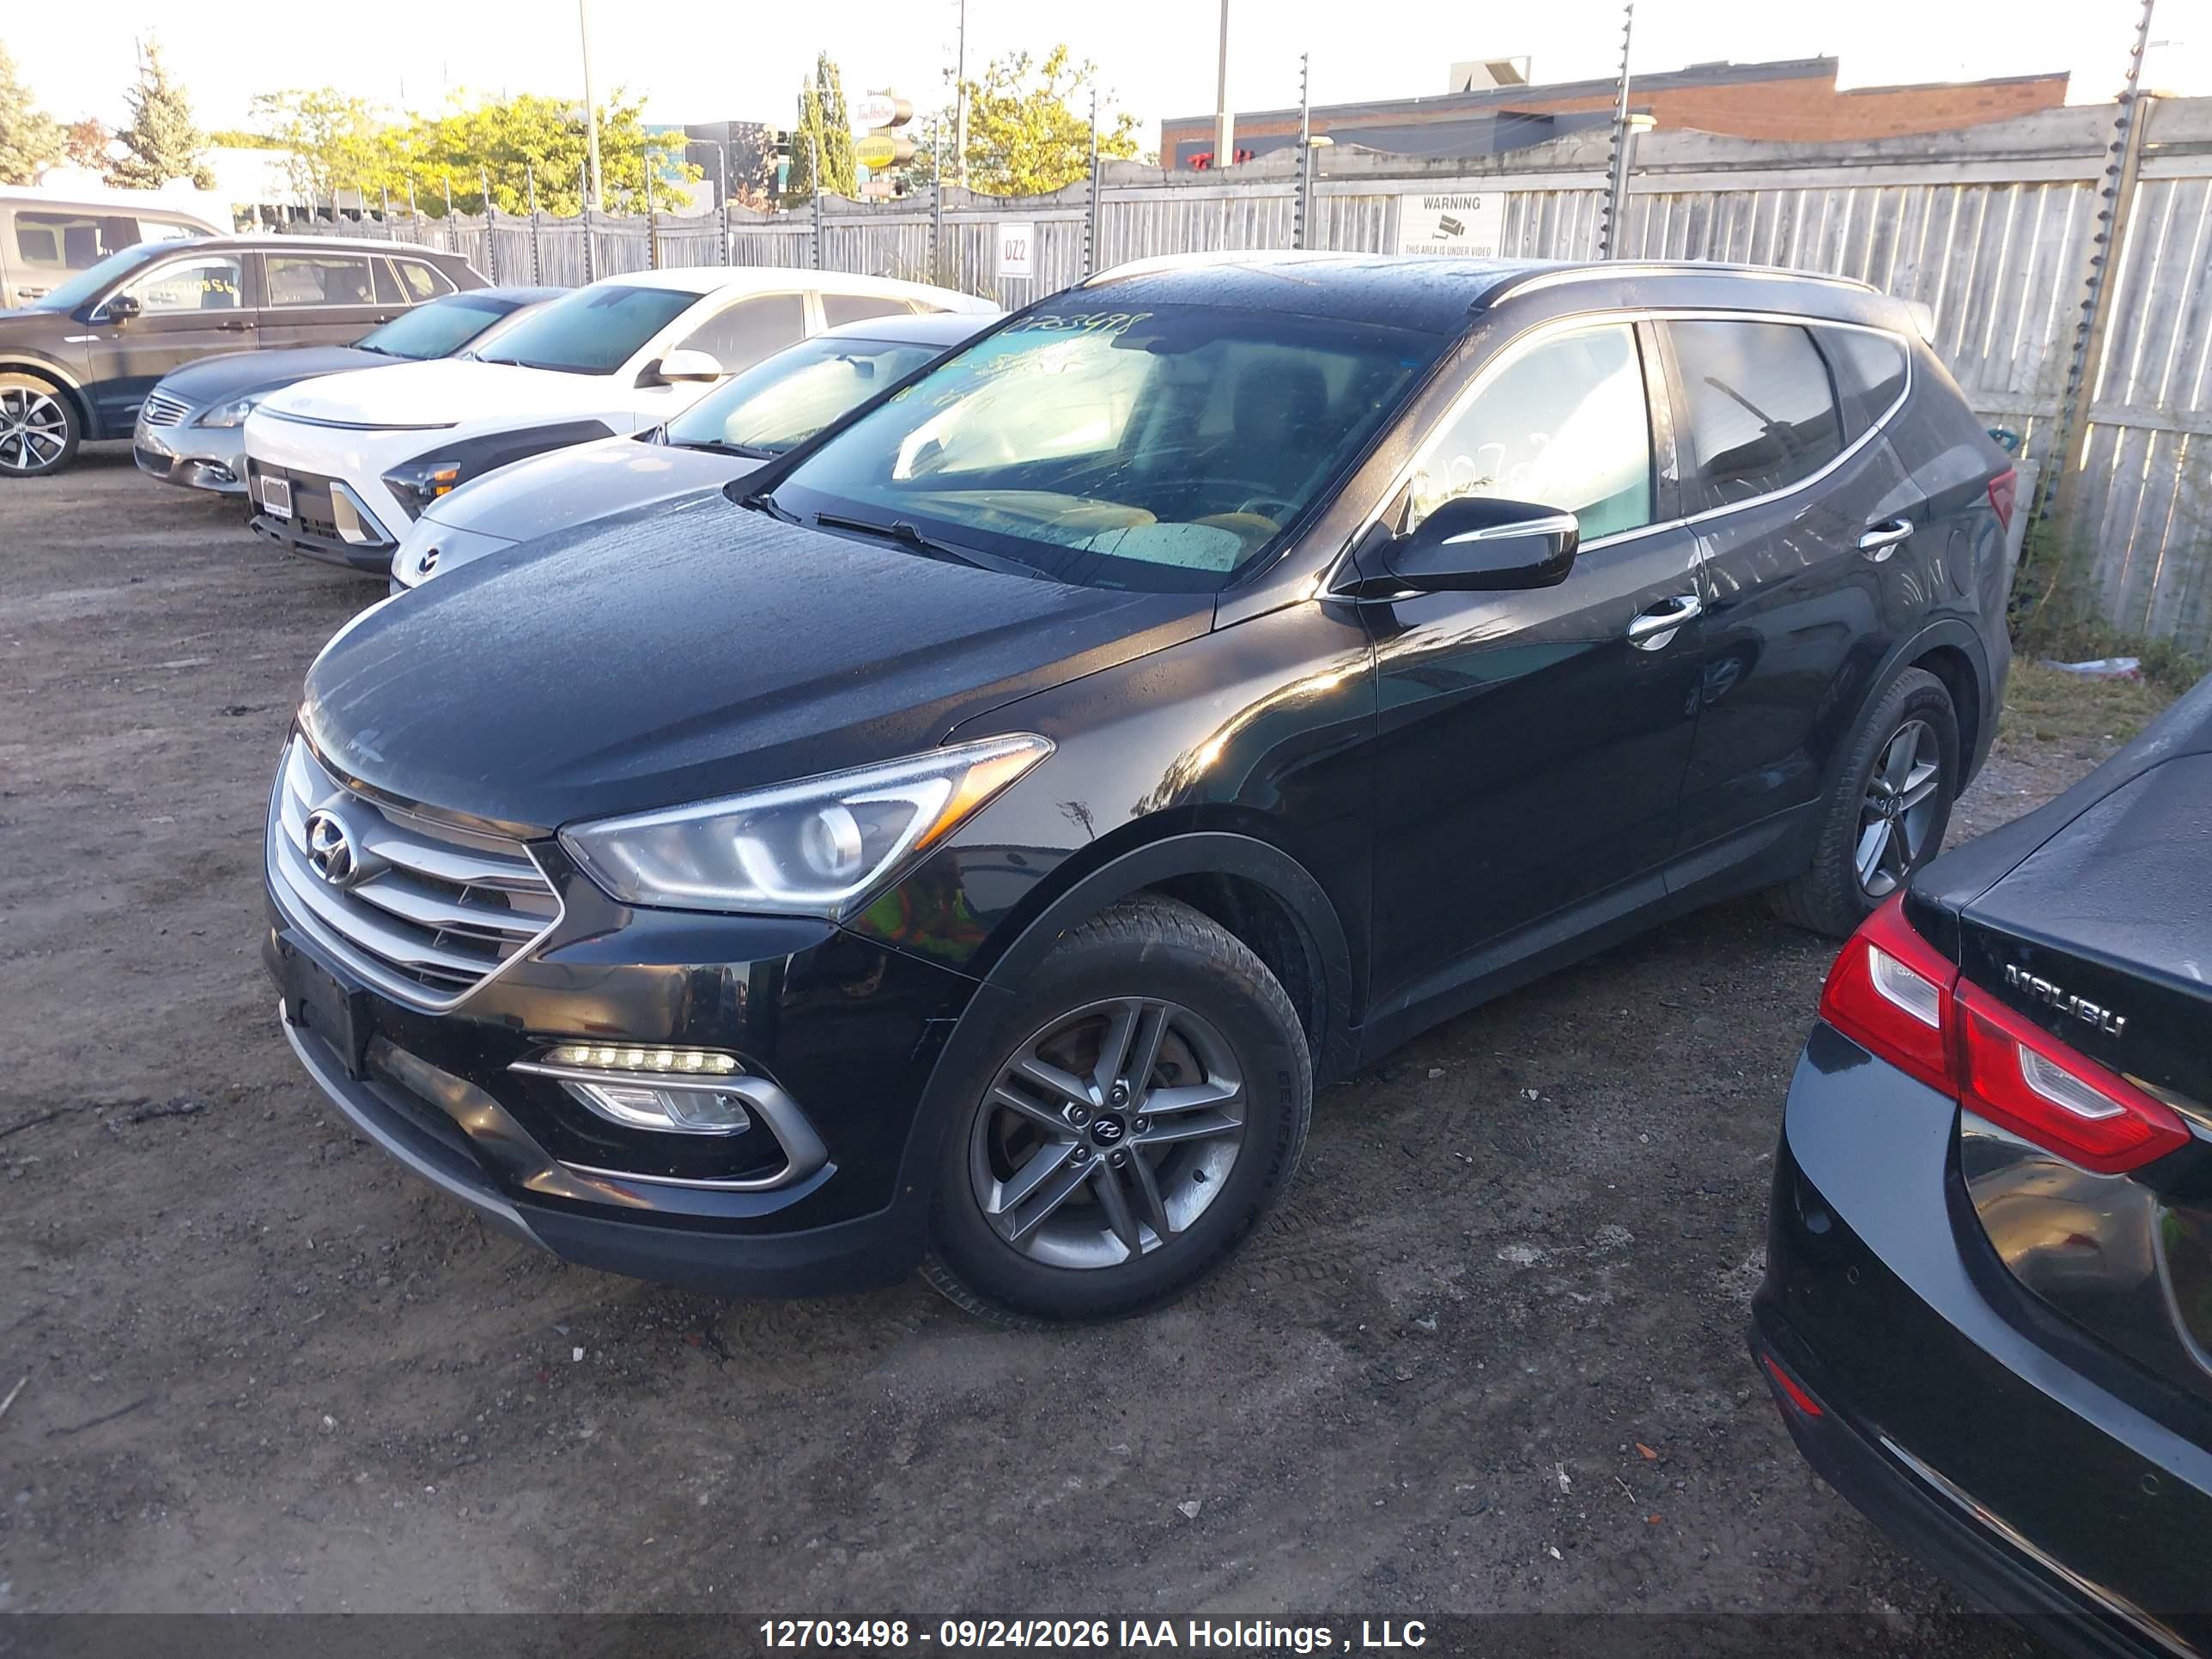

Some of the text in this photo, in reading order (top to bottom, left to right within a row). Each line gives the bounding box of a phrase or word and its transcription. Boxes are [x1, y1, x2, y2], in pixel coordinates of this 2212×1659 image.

[1424, 197, 1480, 210] WARNING
[1006, 240, 1025, 261] DZ2
[1406, 245, 1491, 257] THIS AREA IS UNDER VIDEO
[2005, 963, 2126, 1038] MALIBU
